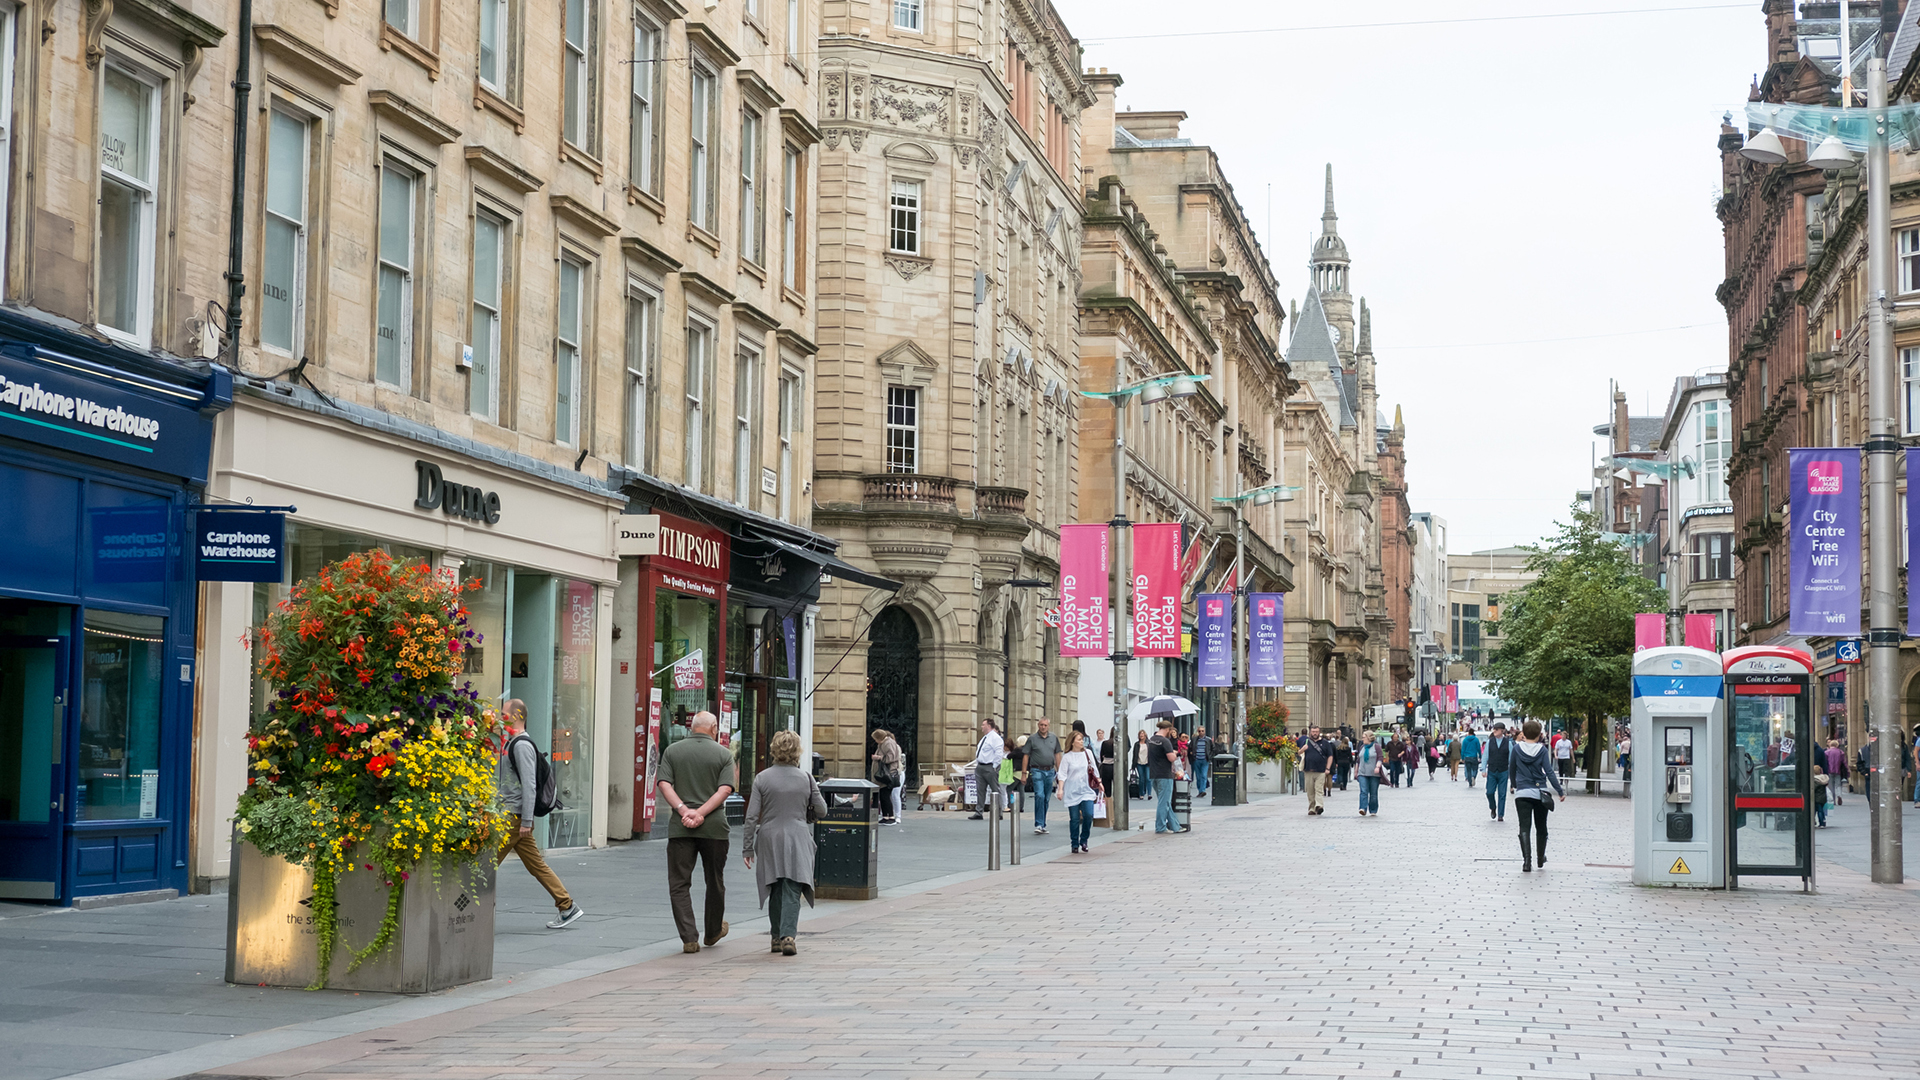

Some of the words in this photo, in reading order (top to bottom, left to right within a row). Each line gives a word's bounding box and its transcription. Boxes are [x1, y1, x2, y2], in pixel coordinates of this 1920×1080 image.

[263, 282, 287, 302] une
[75, 397, 160, 441] Warehouse
[414, 459, 501, 525] Dune
[1812, 509, 1838, 524] City
[620, 530, 655, 540] Dune
[1804, 524, 1846, 537] Centre
[206, 531, 271, 545] Carphone
[201, 545, 276, 558] Warehouse
[660, 525, 721, 570] TIMPSON
[1812, 539, 1839, 552] Free
[1811, 554, 1839, 566] WiFi
[663, 574, 671, 585] The
[1063, 574, 1077, 650] GLASGOW
[1135, 574, 1149, 650] GLASGOW
[1825, 613, 1846, 623] wifi
[1076, 608, 1090, 650] MAKE
[1089, 596, 1103, 650] PEOPLE
[1149, 608, 1162, 650] MAKE
[1161, 596, 1175, 650] PEOPLE
[1208, 623, 1222, 632] City
[1260, 623, 1273, 632] City
[1208, 638, 1222, 646] Free
[1260, 638, 1273, 646] Free
[687, 658, 701, 666] I.D.
[1745, 675, 1764, 683] Coins
[1764, 675, 1771, 683] &
[1772, 675, 1792, 683] Cards
[286, 913, 303, 925] the
